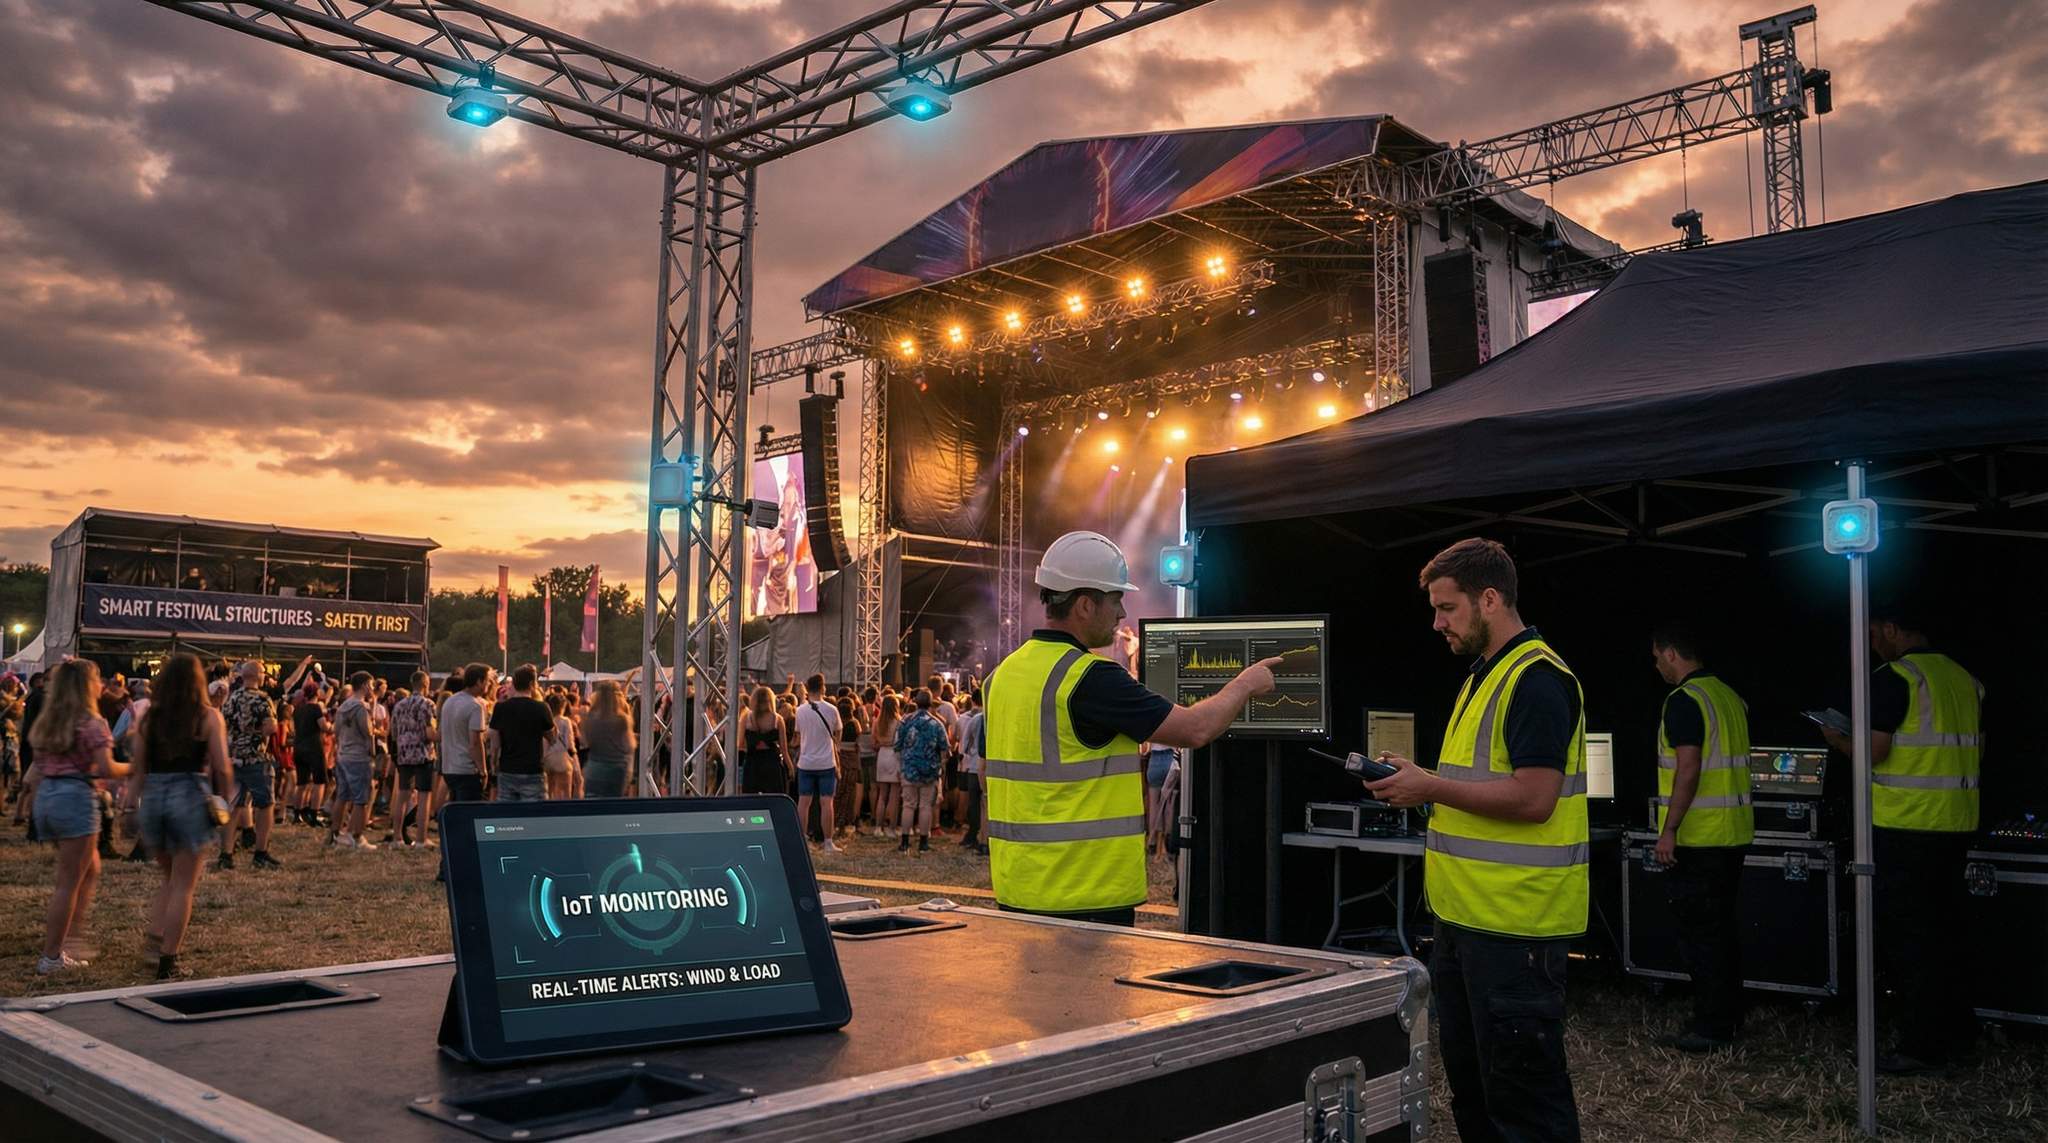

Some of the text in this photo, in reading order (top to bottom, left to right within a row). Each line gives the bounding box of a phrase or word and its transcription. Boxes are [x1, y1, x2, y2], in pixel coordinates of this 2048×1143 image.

[99, 598, 152, 617] SMART
[156, 601, 222, 621] FESTIVAL
[225, 606, 312, 626] STRUCTURES
[324, 612, 373, 630] SAFETY
[375, 615, 410, 632] FIRST
[562, 886, 729, 916] IoT MONITORING
[531, 963, 781, 1000] REAL-TIME ALERTS: WIND & LOAD
